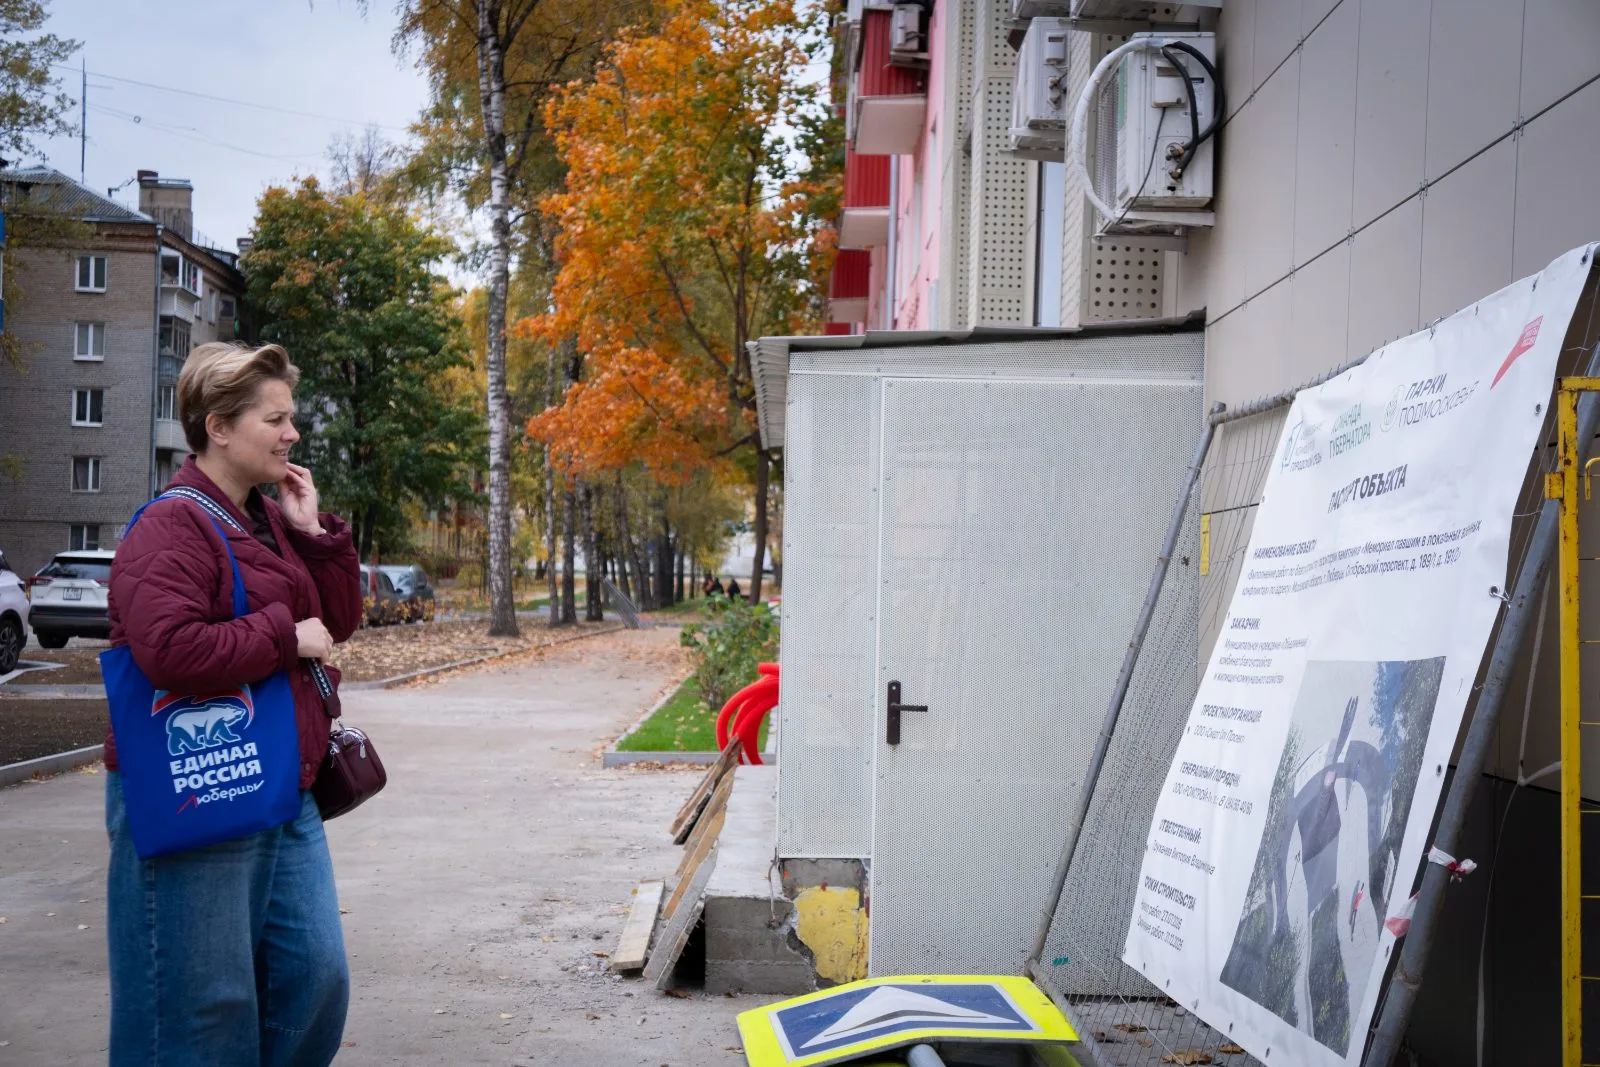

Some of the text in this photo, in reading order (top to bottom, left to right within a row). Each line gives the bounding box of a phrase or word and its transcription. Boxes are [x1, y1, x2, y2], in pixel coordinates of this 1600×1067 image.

[1405, 373, 1448, 401] ПАРКИ
[1327, 464, 1408, 514] ПАСПРТ ОБЪЕКТА
[170, 742, 258, 775] ЕДИНАЯ
[173, 759, 262, 794] РОССИЯ
[176, 780, 265, 815] Люберцы
